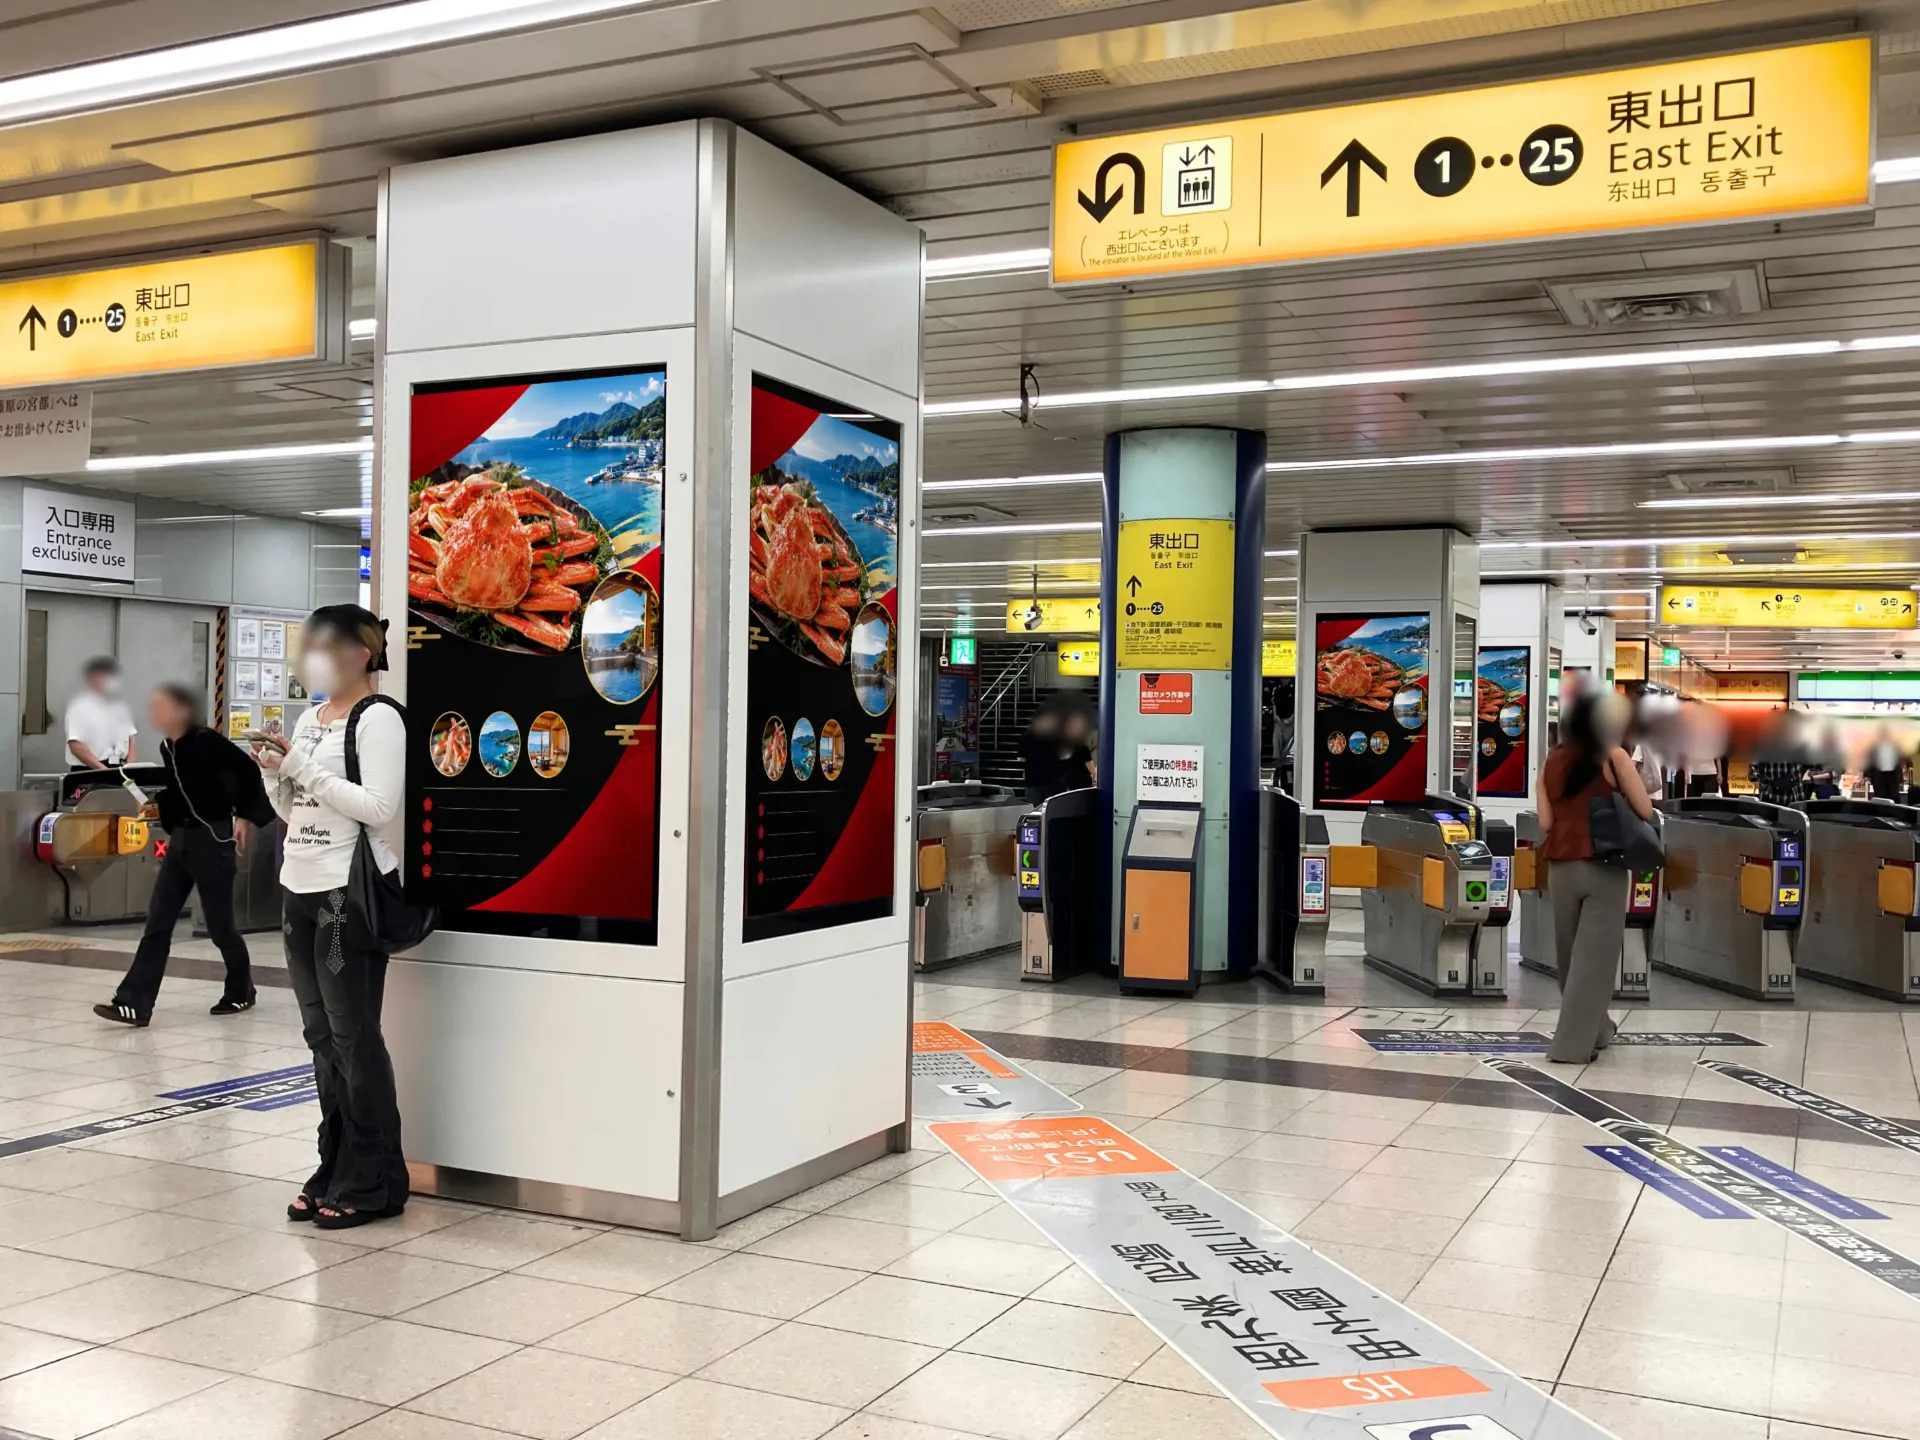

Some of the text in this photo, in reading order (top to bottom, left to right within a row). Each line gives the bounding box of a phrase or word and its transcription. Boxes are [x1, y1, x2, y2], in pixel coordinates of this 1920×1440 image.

[1607, 77, 1756, 134] 東出口
[1528, 137, 1575, 173] 25
[1609, 126, 1783, 174] East Exit
[1607, 177, 1677, 202] 东出口
[1701, 165, 1777, 193] 동출구
[1118, 223, 1190, 240] エレベーターは
[1106, 236, 1200, 255] 西出口にございます
[1089, 258, 1100, 266] The
[1102, 256, 1129, 265] elevator
[1137, 253, 1161, 262] located
[1163, 252, 1171, 260] at
[1172, 250, 1183, 258] the
[1184, 248, 1202, 257] West
[135, 283, 190, 312] 東出口
[107, 309, 124, 327] 25
[136, 328, 178, 342] East Exit
[45, 506, 115, 534] 入口専用
[47, 529, 112, 551] Entrance
[1149, 532, 1199, 549] 東出口
[32, 545, 126, 567] exclusive use
[1154, 561, 1193, 569] East Exit
[1142, 759, 1198, 771] ご使用済みの特急券は
[1142, 776, 1198, 788] この箱にお入れ下さい
[1024, 829, 1034, 837] IC
[1784, 844, 1794, 852] IC
[1111, 1242, 1319, 1371] 西九条 尼崎
[1271, 1286, 1421, 1361] 甲子園
[1341, 1376, 1414, 1400] HS
